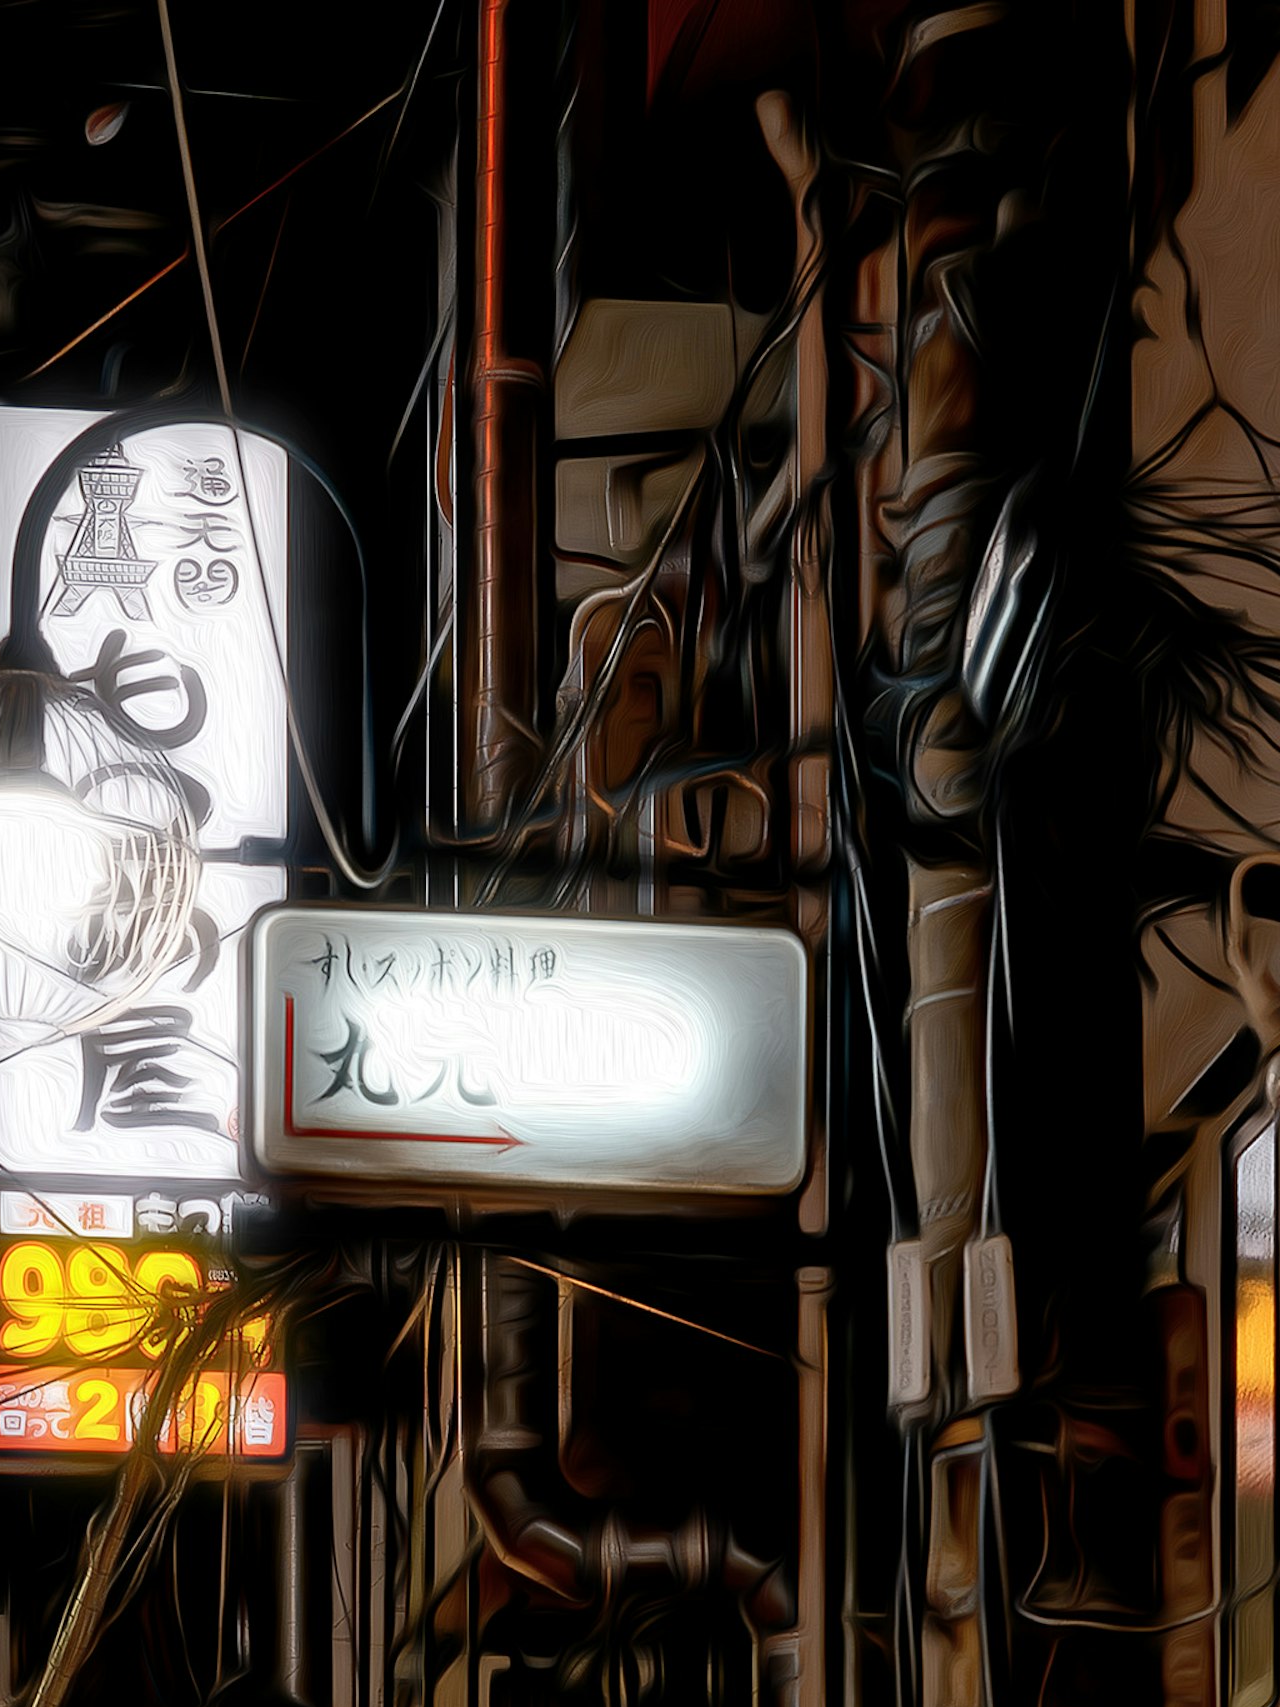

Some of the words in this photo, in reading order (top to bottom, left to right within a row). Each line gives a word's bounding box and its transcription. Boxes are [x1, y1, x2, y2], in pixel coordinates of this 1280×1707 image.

[174, 458, 239, 609] 通天閣
[68, 628, 222, 1133] もつ屋
[25, 1200, 107, 1230] 元祖
[135, 1192, 269, 1234] もつ
